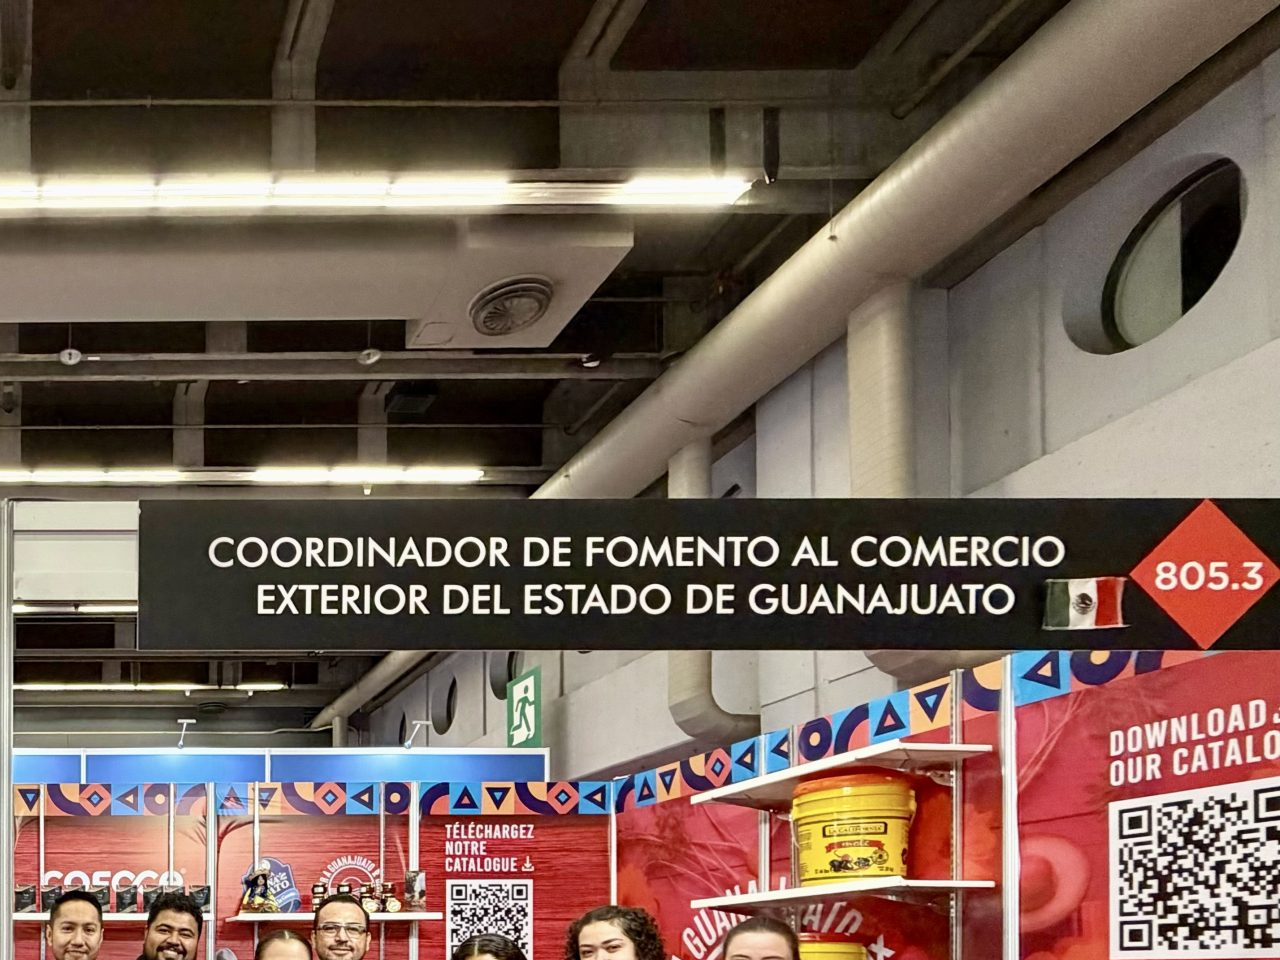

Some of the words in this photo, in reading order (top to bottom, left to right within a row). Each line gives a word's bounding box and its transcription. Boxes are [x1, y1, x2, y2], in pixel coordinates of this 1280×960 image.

[208, 536, 511, 568] COORDINADOR
[523, 536, 571, 567] DE
[585, 535, 780, 568] FOMENTO
[791, 535, 838, 567] AL
[850, 535, 1066, 568] COMERCIO
[1154, 561, 1265, 592] 805.3
[257, 583, 430, 615] EXTERIOR
[442, 583, 511, 615] DEL
[523, 583, 672, 615] ESTADO
[686, 583, 735, 615] DE
[748, 583, 1016, 616] GUANAJUATO
[1109, 698, 1267, 757] DOWNLOAD
[1109, 753, 1162, 787] OUR
[1172, 729, 1280, 776] CATALO
[445, 822, 535, 839] TÉLÉCHARGEZ
[327, 855, 376, 873] GUANAJUATO
[445, 841, 487, 856] NOTRE
[445, 857, 518, 873] CATALOGUE
